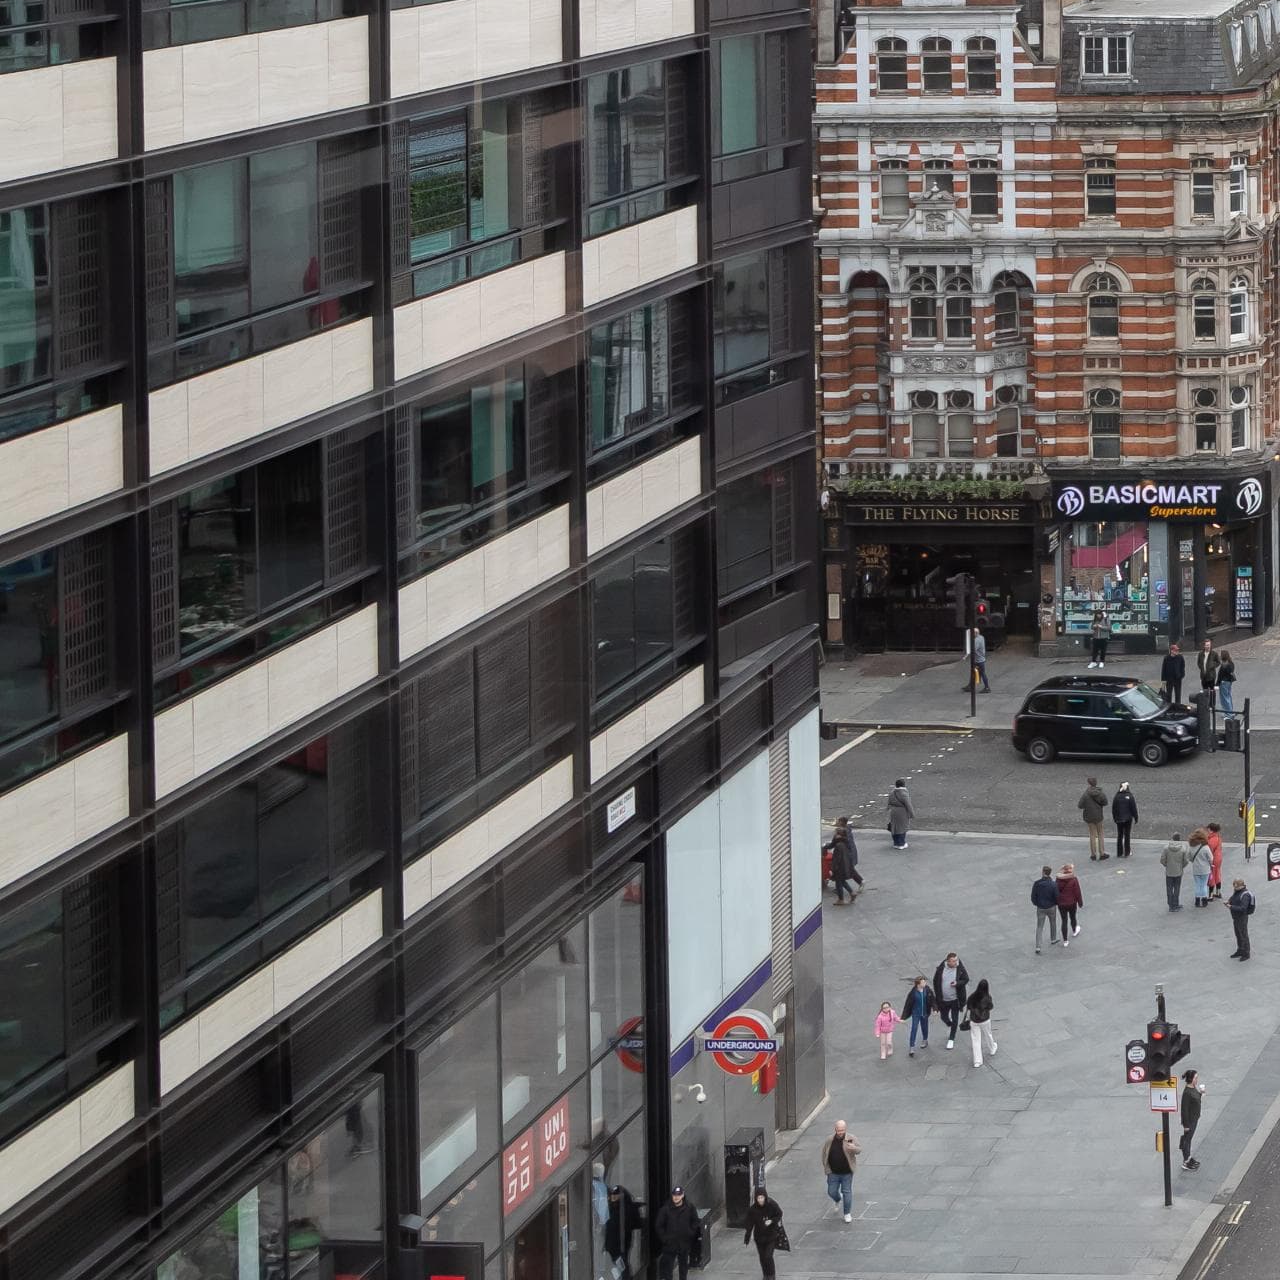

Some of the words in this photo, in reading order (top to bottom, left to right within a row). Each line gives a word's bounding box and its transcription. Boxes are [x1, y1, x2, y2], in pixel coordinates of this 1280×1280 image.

[1089, 485, 1222, 504] BASICMART
[863, 507, 895, 520] THE
[903, 507, 957, 520] FLYING
[966, 507, 1020, 520] HORSE
[1150, 506, 1217, 517] Superstore
[707, 1041, 774, 1050] UNDERGROUND
[1159, 1093, 1168, 1101] 14
[544, 1108, 564, 1141] UNI
[545, 1131, 566, 1167] QLO
